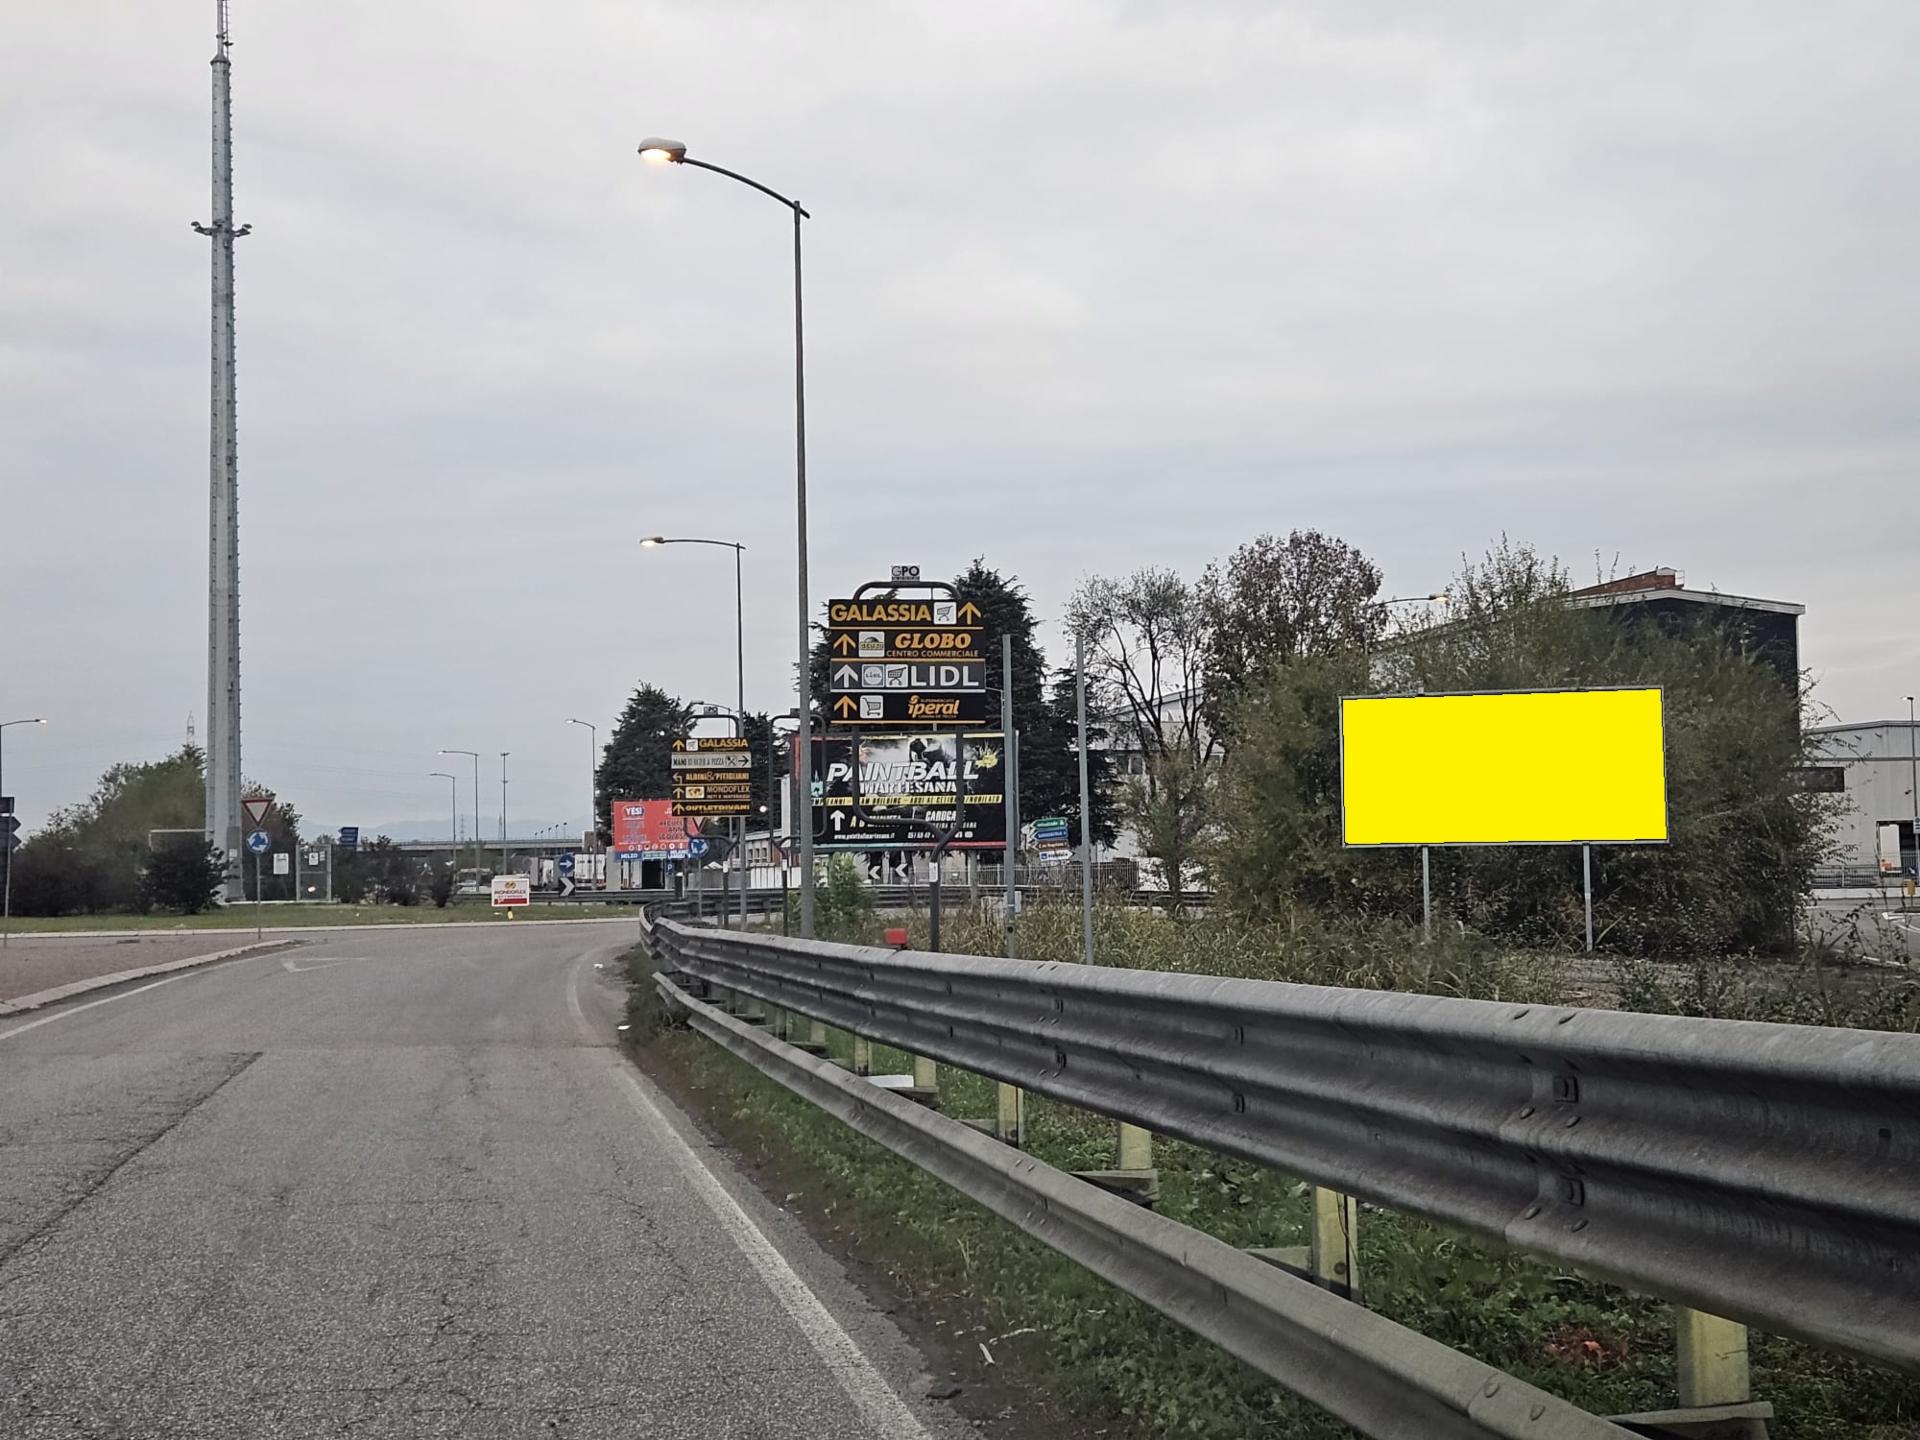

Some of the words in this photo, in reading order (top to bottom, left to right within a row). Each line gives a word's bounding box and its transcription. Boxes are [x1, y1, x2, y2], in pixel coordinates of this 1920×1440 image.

[830, 604, 932, 621] GALASSIA
[895, 633, 972, 649] GLOBO
[910, 665, 980, 687] LIDL
[907, 695, 960, 719] iperal
[699, 739, 749, 748] GALASSIA
[826, 761, 979, 782] PAINTBALL
